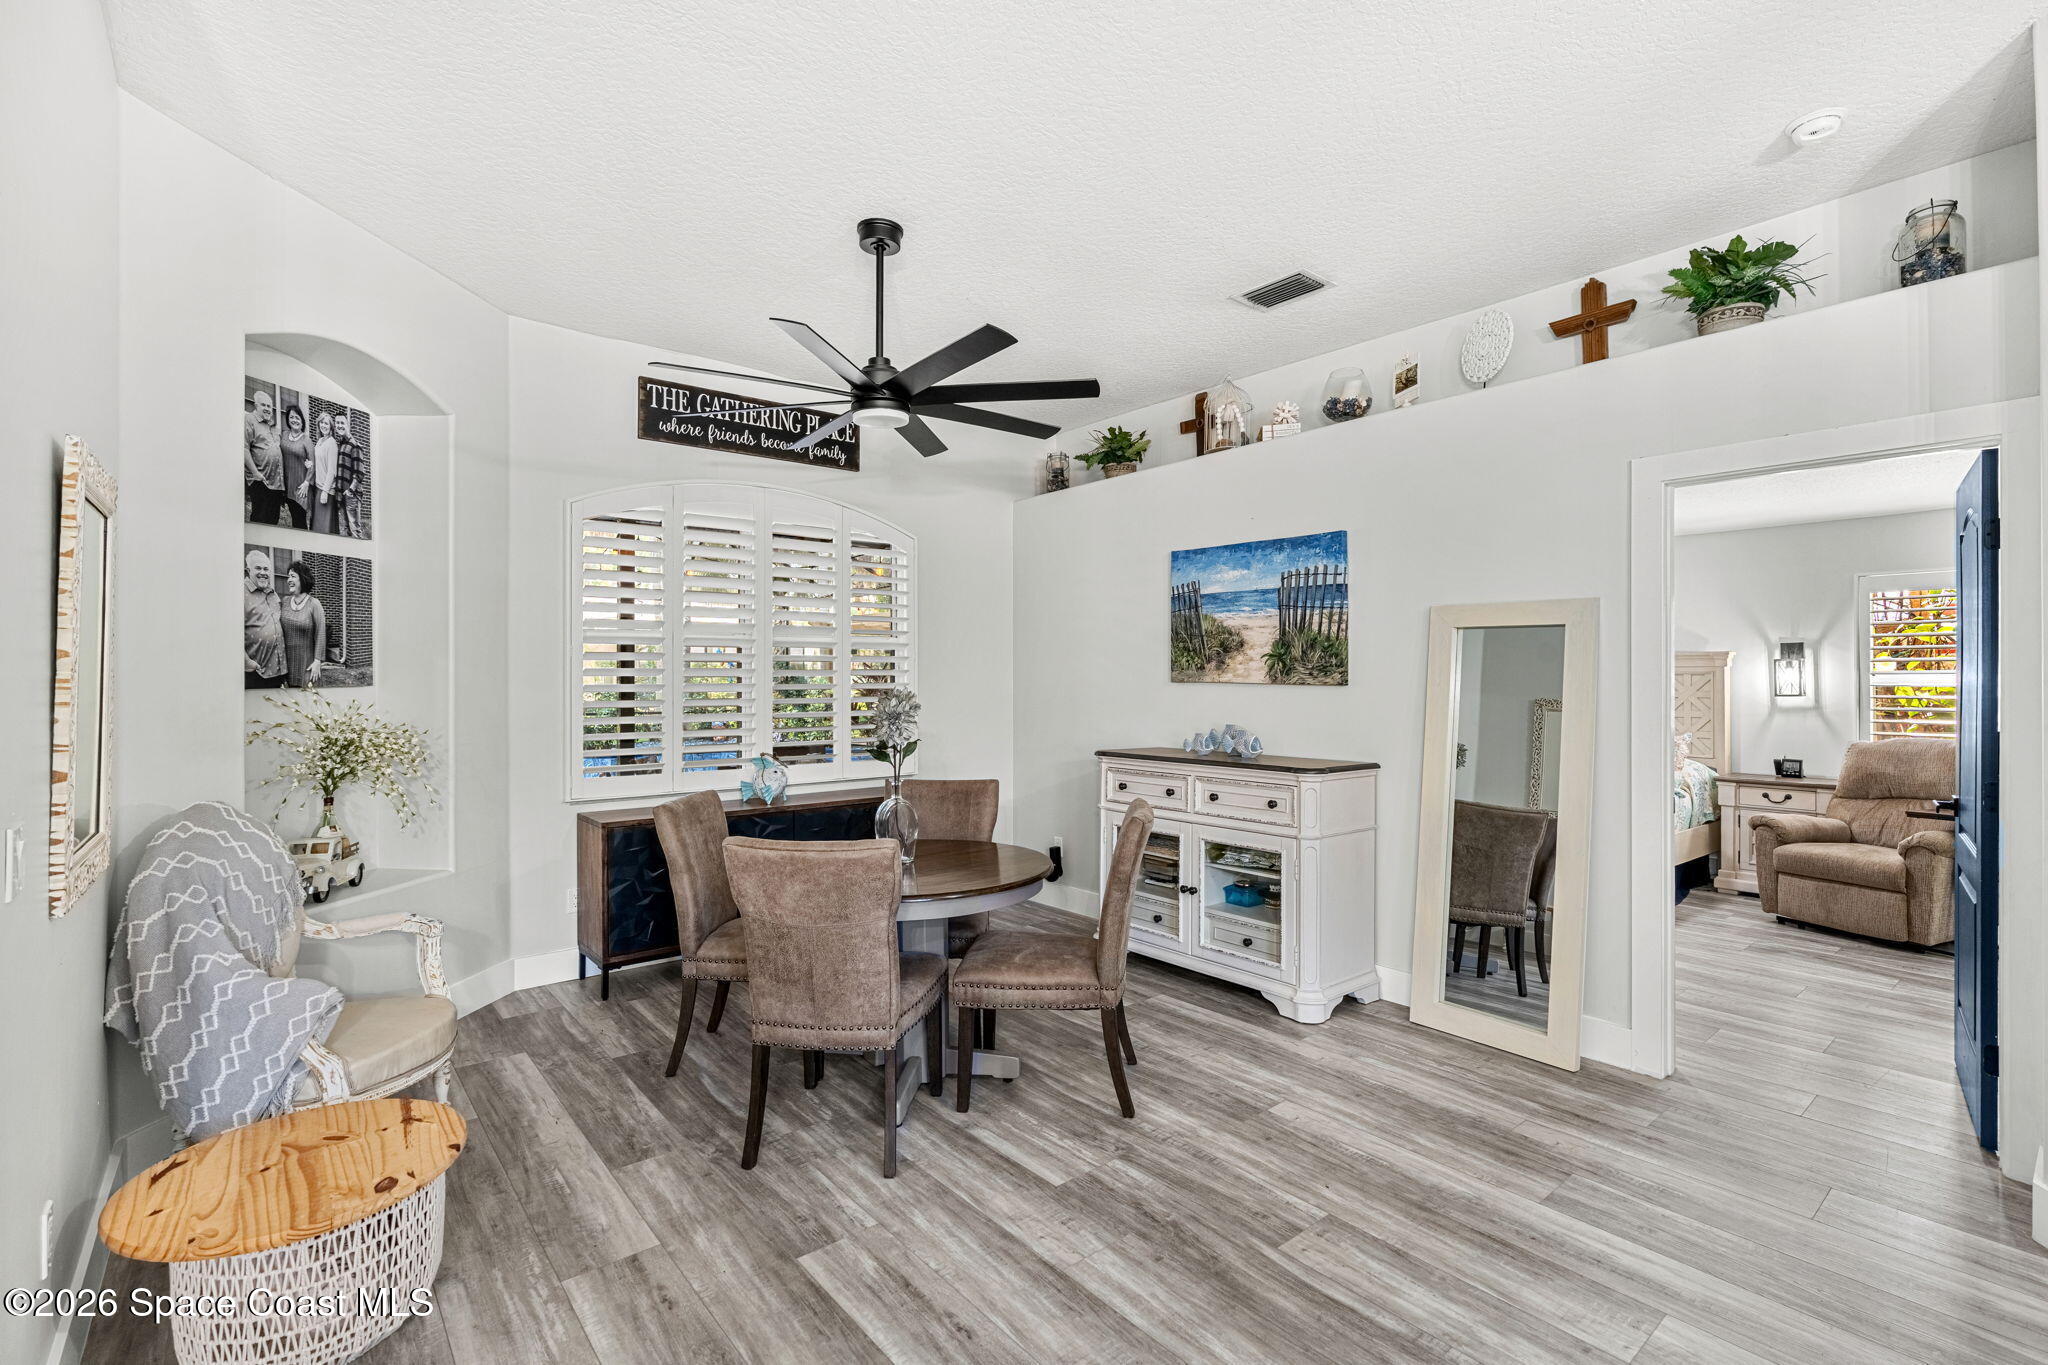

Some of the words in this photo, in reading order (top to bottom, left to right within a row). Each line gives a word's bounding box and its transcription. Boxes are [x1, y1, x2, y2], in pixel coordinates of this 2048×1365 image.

[647, 383, 691, 413] THE
[696, 393, 802, 434] GATHERING
[658, 417, 704, 437] where
[708, 424, 757, 446] friends
[808, 444, 847, 466] family
